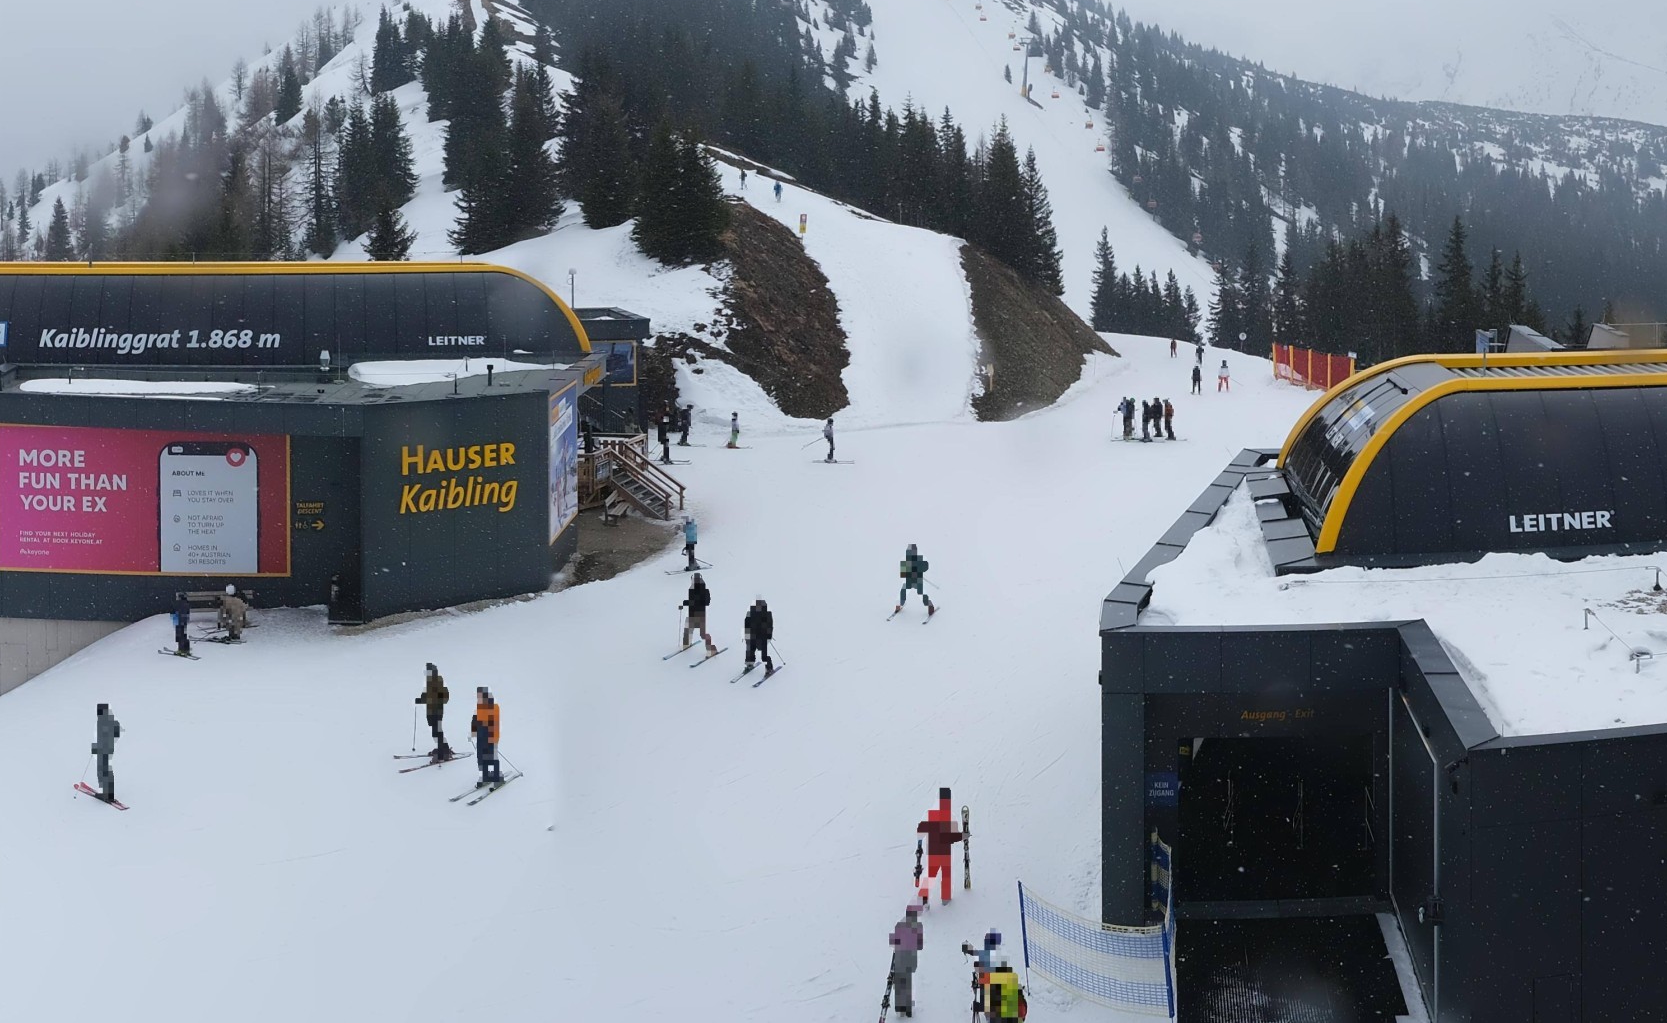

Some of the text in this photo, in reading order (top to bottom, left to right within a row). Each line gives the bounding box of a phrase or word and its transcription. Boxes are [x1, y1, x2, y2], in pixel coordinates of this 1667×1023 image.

[39, 328, 280, 354] Kaiblinggrat 1.868 m
[428, 335, 485, 346] LEITNER
[19, 449, 85, 468] MORE
[402, 442, 516, 475] HAUSER
[19, 472, 127, 491] FUN THAN
[20, 494, 107, 512] YOUR EX
[400, 477, 518, 514] Kaibling
[1509, 510, 1613, 533] LEITNER
[1240, 710, 1287, 721] Ausgang
[1294, 709, 1315, 719] Exit
[1149, 789, 1175, 798] ZUGANG
[1154, 781, 1169, 789] KEIN
